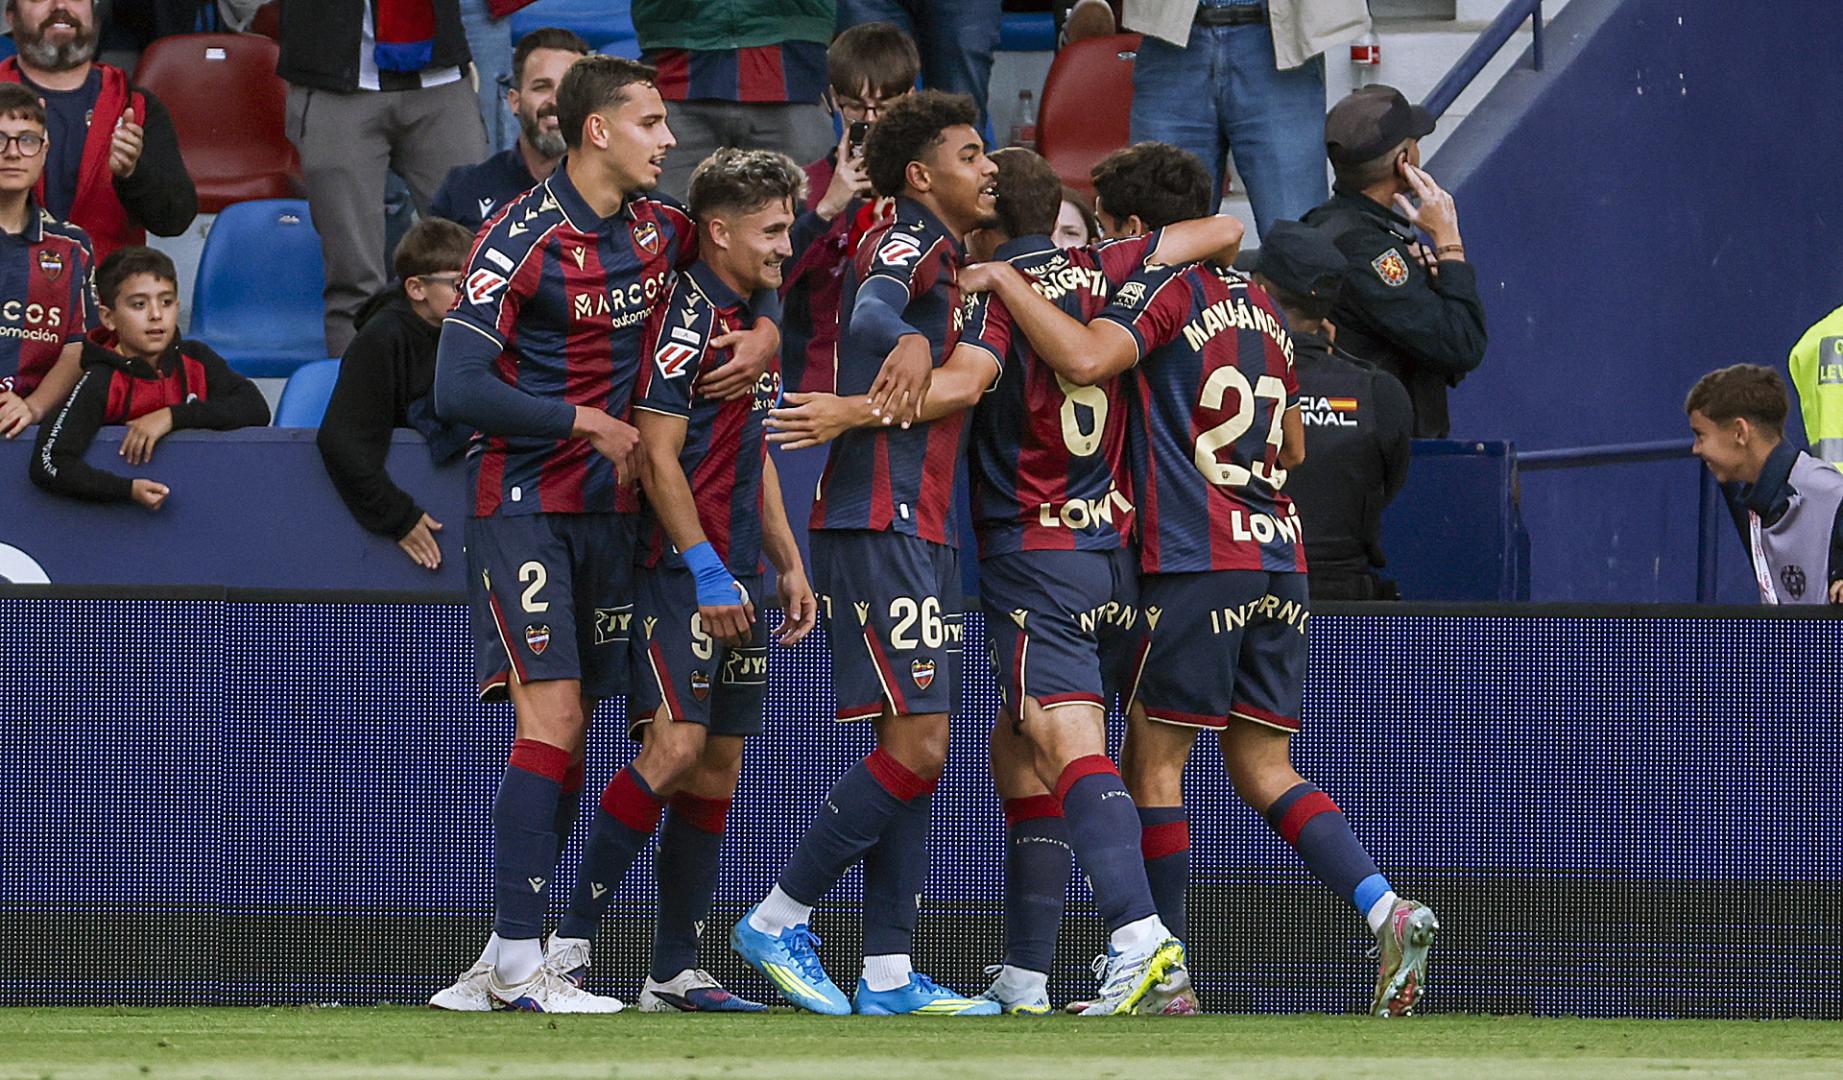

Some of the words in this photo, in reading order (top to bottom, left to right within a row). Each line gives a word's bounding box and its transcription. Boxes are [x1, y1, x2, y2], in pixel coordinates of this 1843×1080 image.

[1301, 411, 1357, 426] NAL
[518, 560, 549, 612] 2
[889, 596, 943, 649] 26
